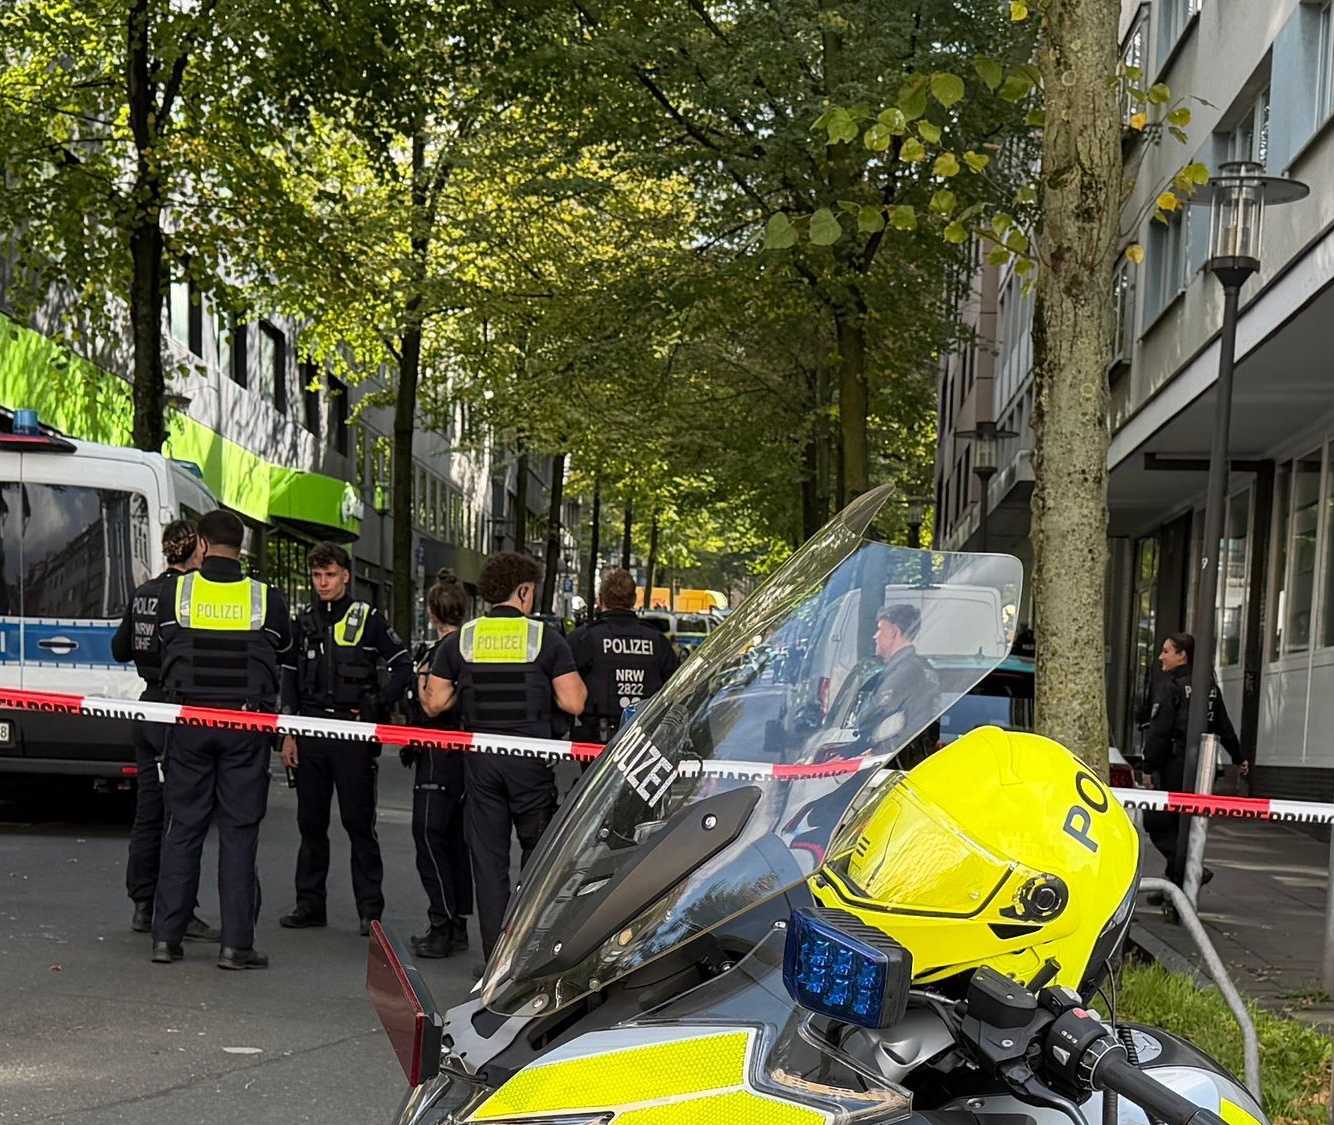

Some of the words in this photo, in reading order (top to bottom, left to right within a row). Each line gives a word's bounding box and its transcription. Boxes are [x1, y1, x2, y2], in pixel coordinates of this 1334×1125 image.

[196, 603, 244, 620] POLIZEI
[477, 635, 523, 650] POLIZEI
[603, 638, 654, 656] POLIZEI
[616, 669, 645, 683] NRW
[617, 683, 644, 696] 2822
[1062, 756, 1109, 853] PO
